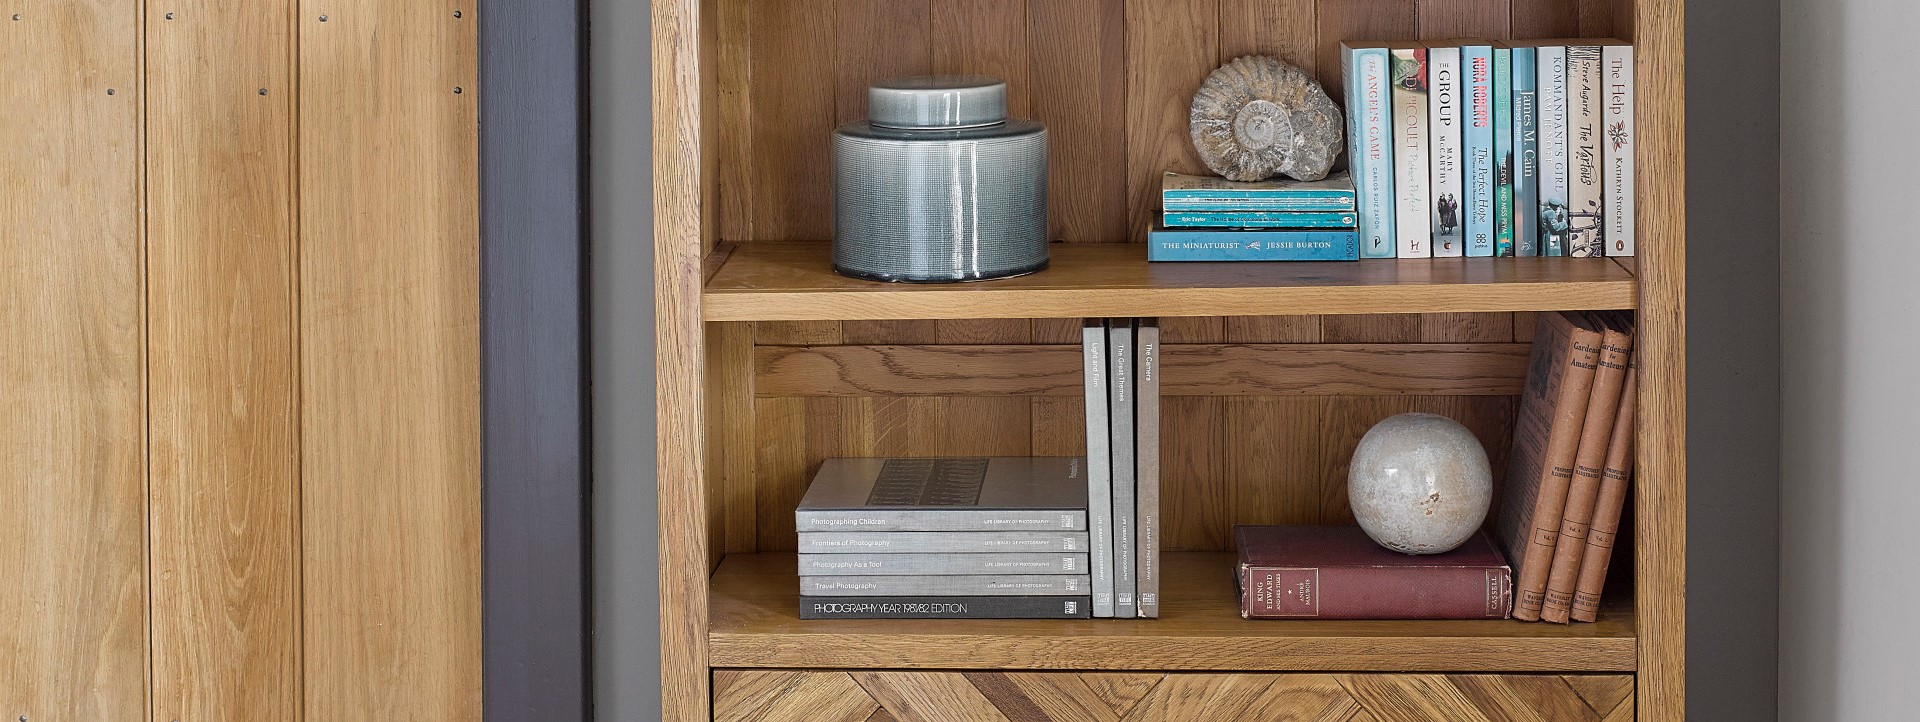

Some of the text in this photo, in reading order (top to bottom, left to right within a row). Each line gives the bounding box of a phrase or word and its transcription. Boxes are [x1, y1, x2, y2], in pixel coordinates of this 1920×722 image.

[1472, 57, 1488, 128] NORA ROBERTS
[1582, 60, 1590, 84] Steve
[1609, 58, 1625, 115] The Help
[1368, 74, 1378, 122] ANGEL'S
[1438, 70, 1451, 126] GROUP
[1580, 84, 1591, 117] Augarde
[1369, 126, 1380, 160] GAME
[1520, 88, 1536, 177] James M. Cain
[1544, 87, 1552, 164] PAM JENOFF
[1554, 56, 1563, 192] KOMMANDANT'S GIRL
[1580, 123, 1592, 142] The
[1477, 147, 1488, 223] The Perfect Hope
[1346, 234, 1354, 258] PICADOR
[1091, 342, 1099, 359] Light
[811, 518, 858, 526] Photographing
[814, 603, 877, 613] PHOTOGRAPHY
[877, 603, 901, 613] YEAR
[931, 603, 968, 613] EDITION
